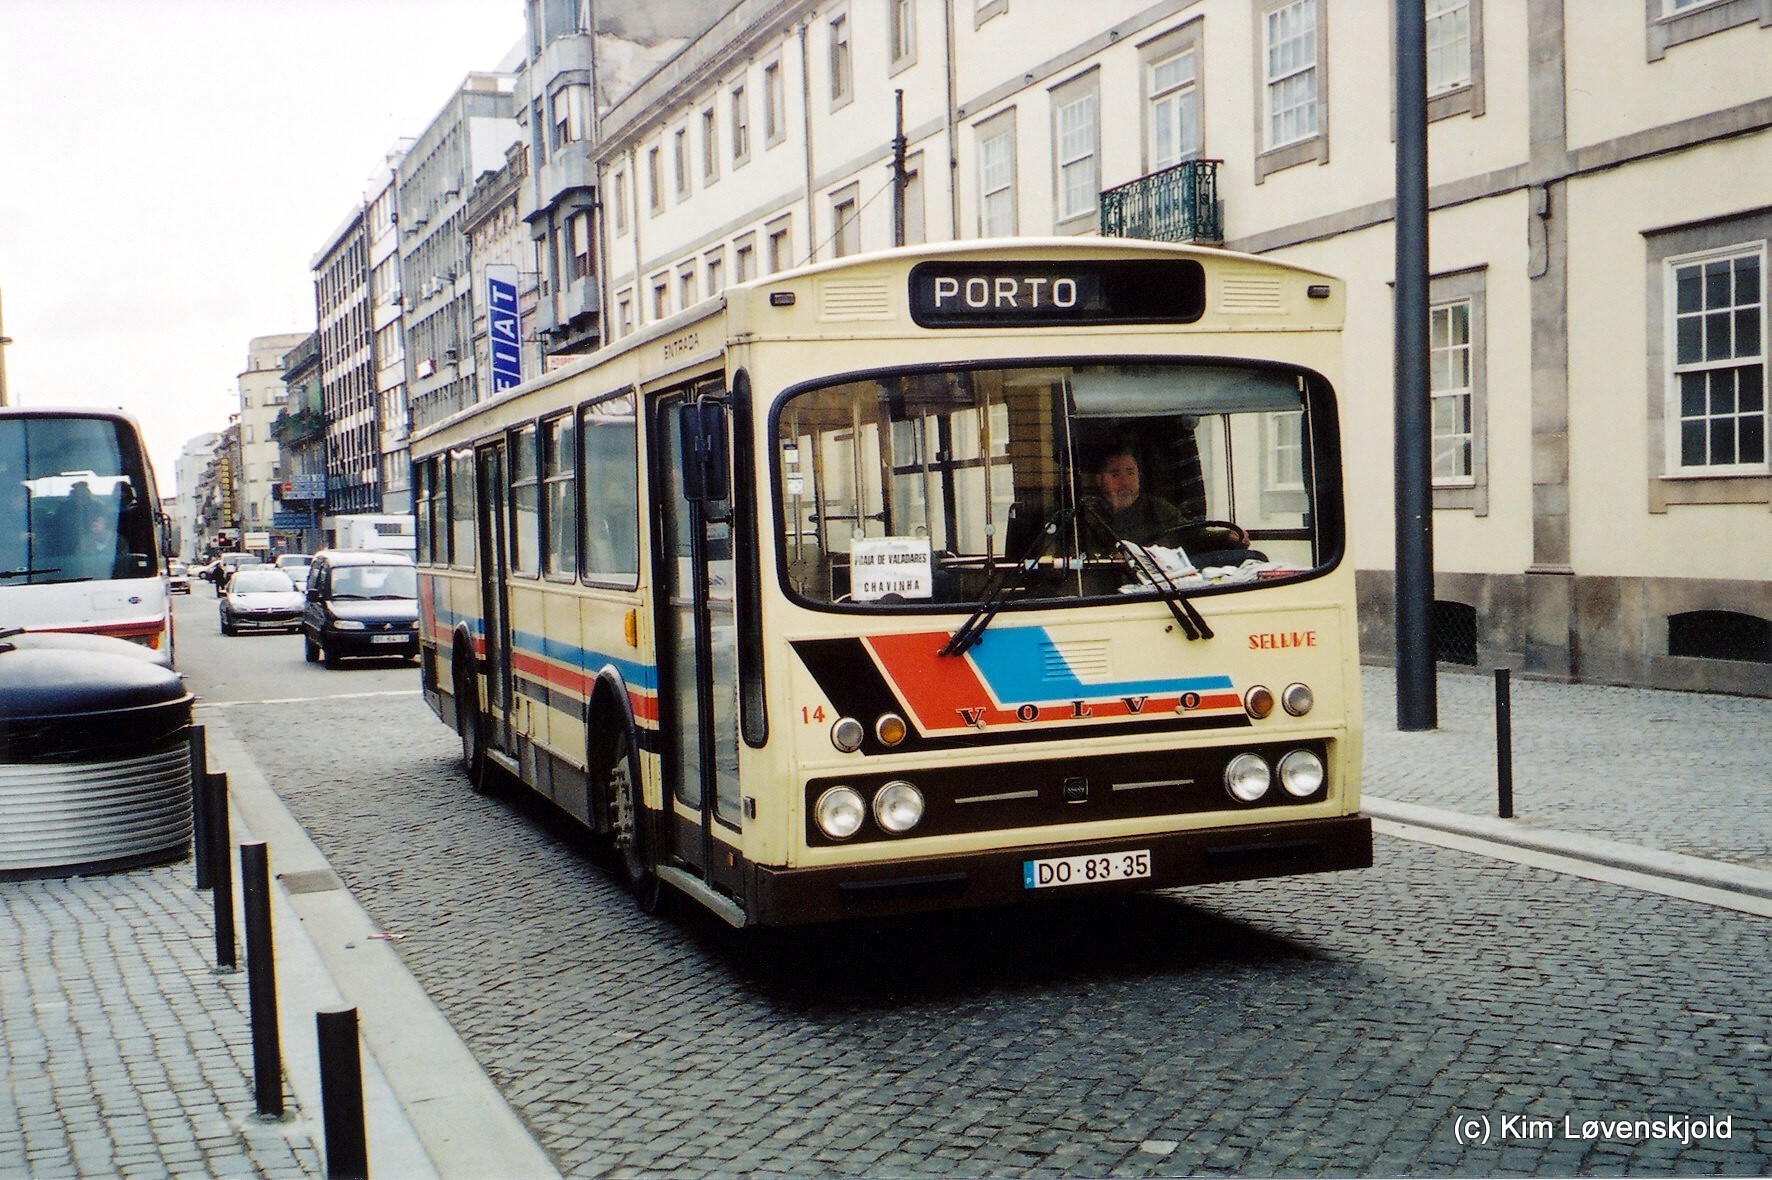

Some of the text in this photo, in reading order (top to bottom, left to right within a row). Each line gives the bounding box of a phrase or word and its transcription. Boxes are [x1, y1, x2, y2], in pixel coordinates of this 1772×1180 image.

[934, 277, 1077, 308] PORTO
[493, 285, 518, 393] FIAT
[664, 332, 700, 360] ENTRADA
[877, 555, 886, 565] DE
[888, 553, 927, 565] VALADARES
[864, 580, 920, 592] CHAVINHA
[802, 705, 826, 724] 14
[956, 691, 1201, 727] VOLVO
